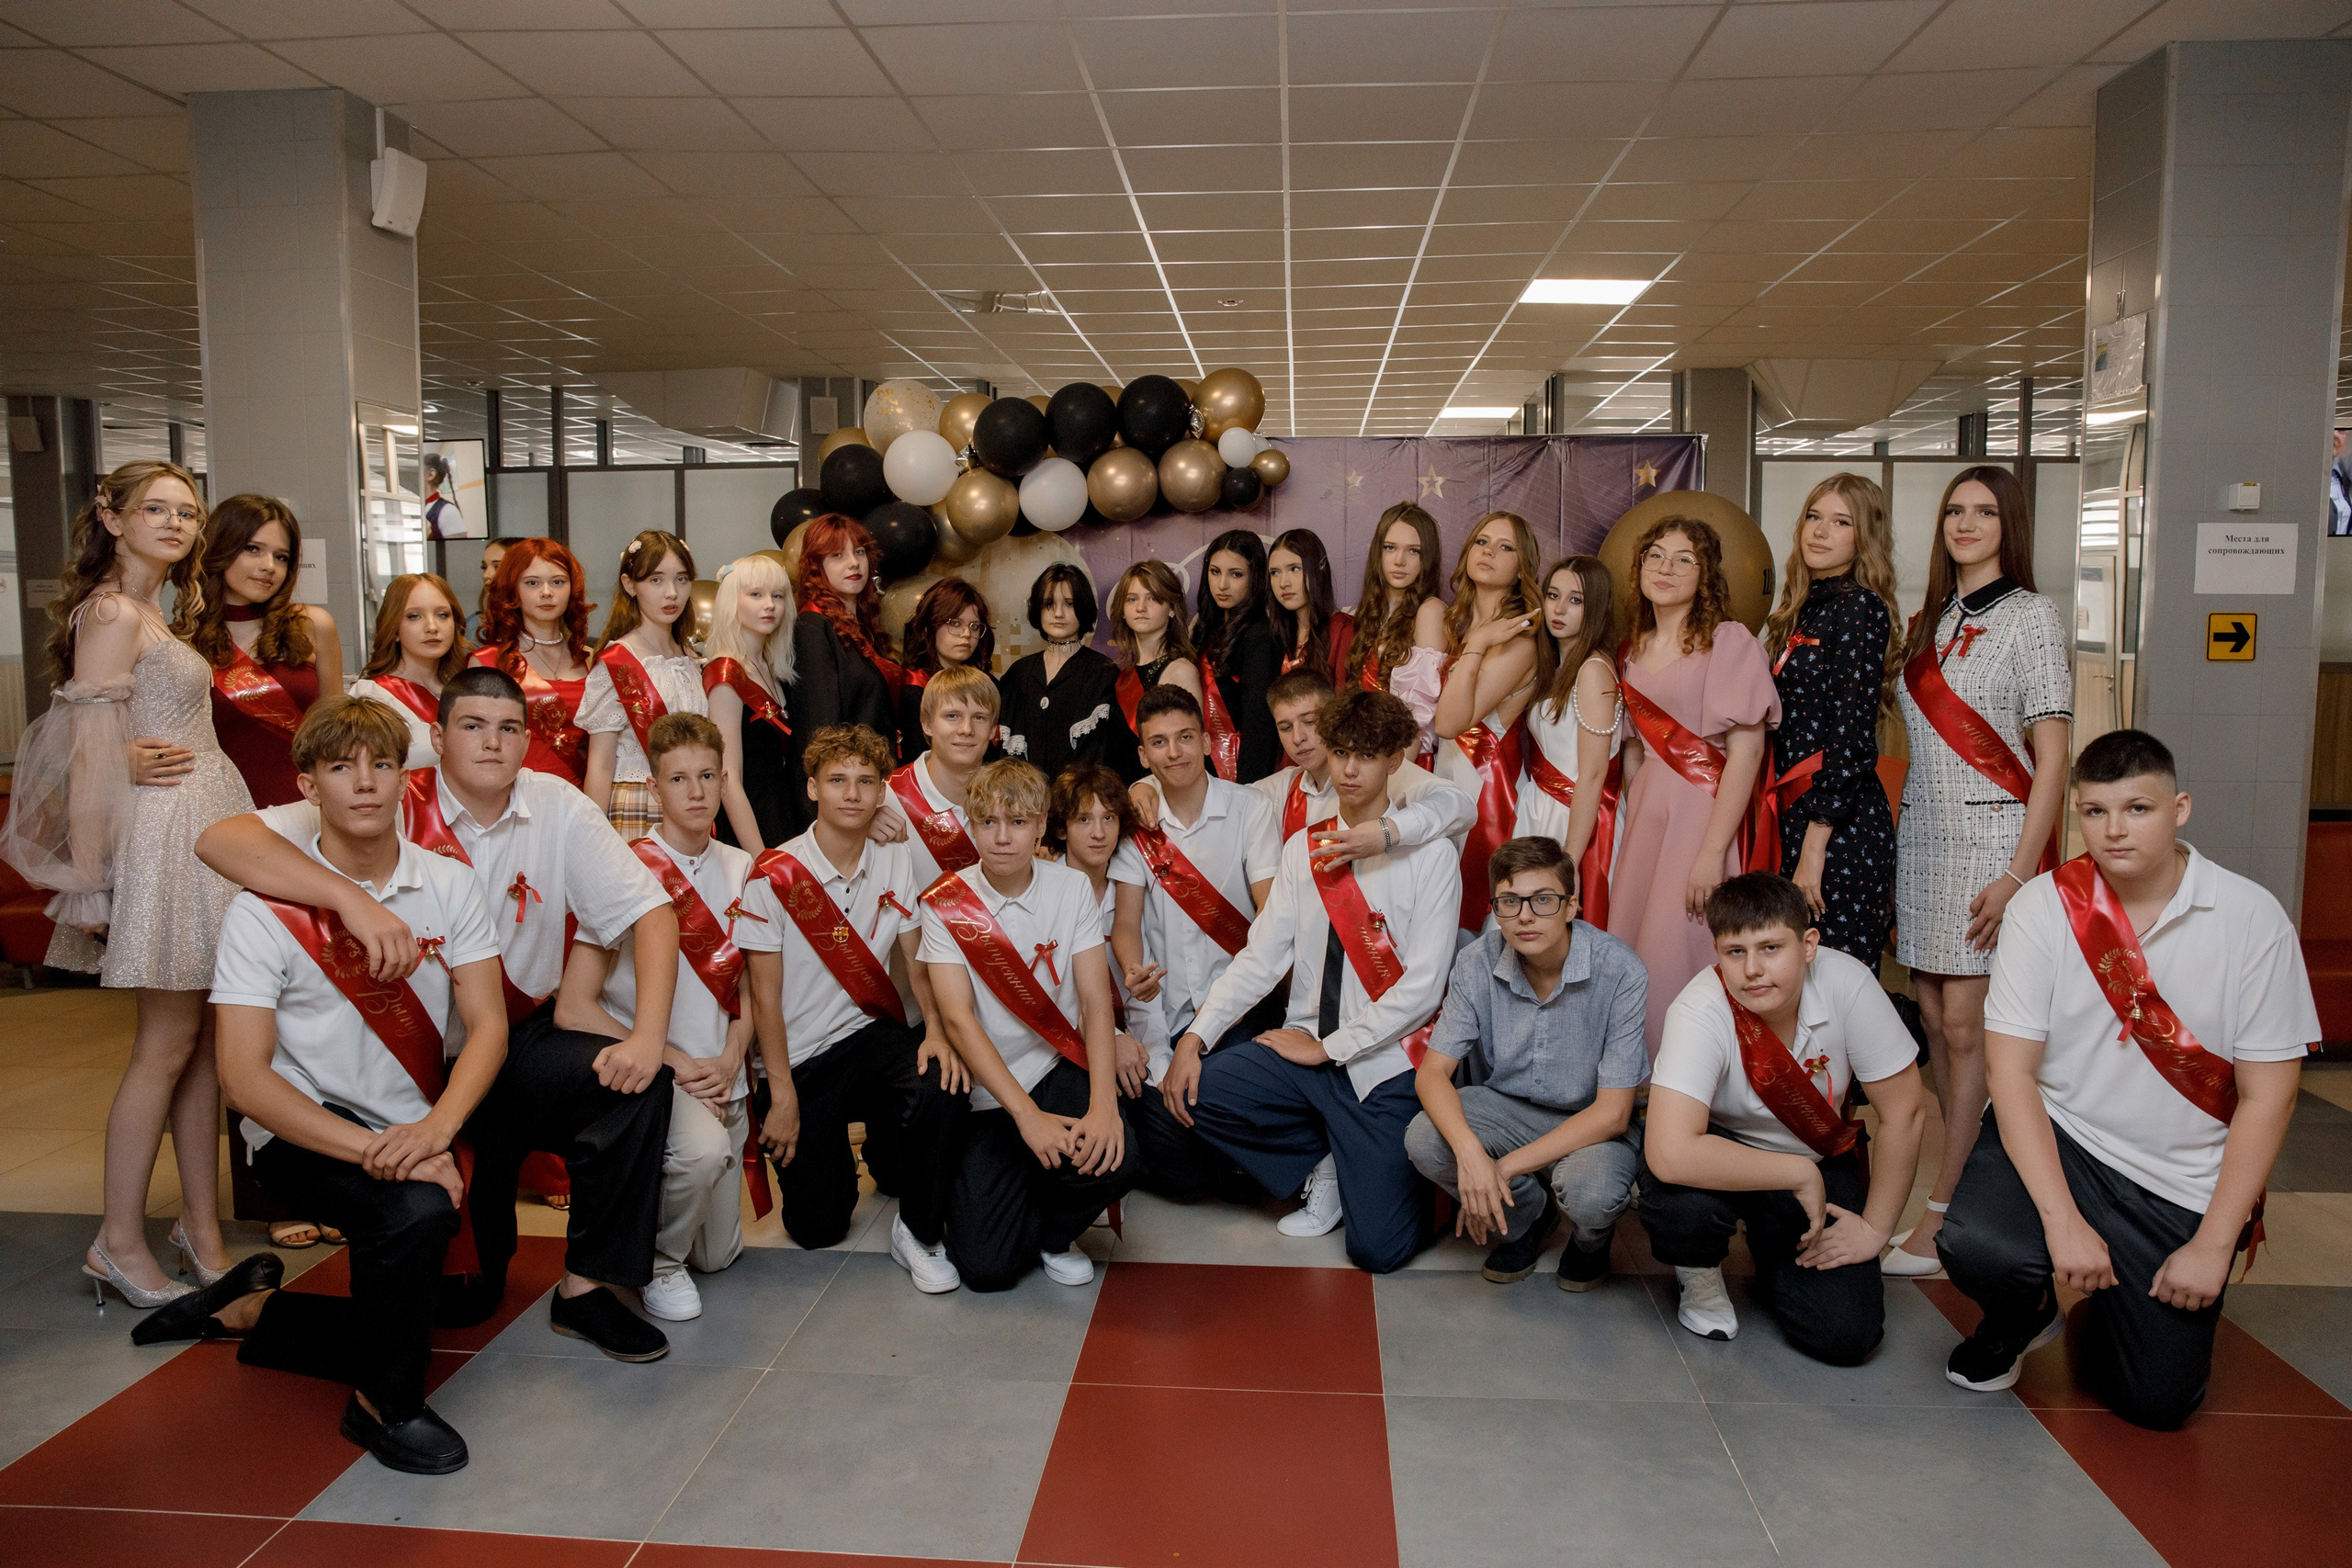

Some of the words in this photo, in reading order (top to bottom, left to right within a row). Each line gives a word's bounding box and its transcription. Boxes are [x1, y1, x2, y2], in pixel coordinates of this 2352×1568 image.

[2225, 535, 2252, 543] Места
[2208, 547, 2285, 556] сопровождающих
[950, 907, 1036, 1006] Выпускник
